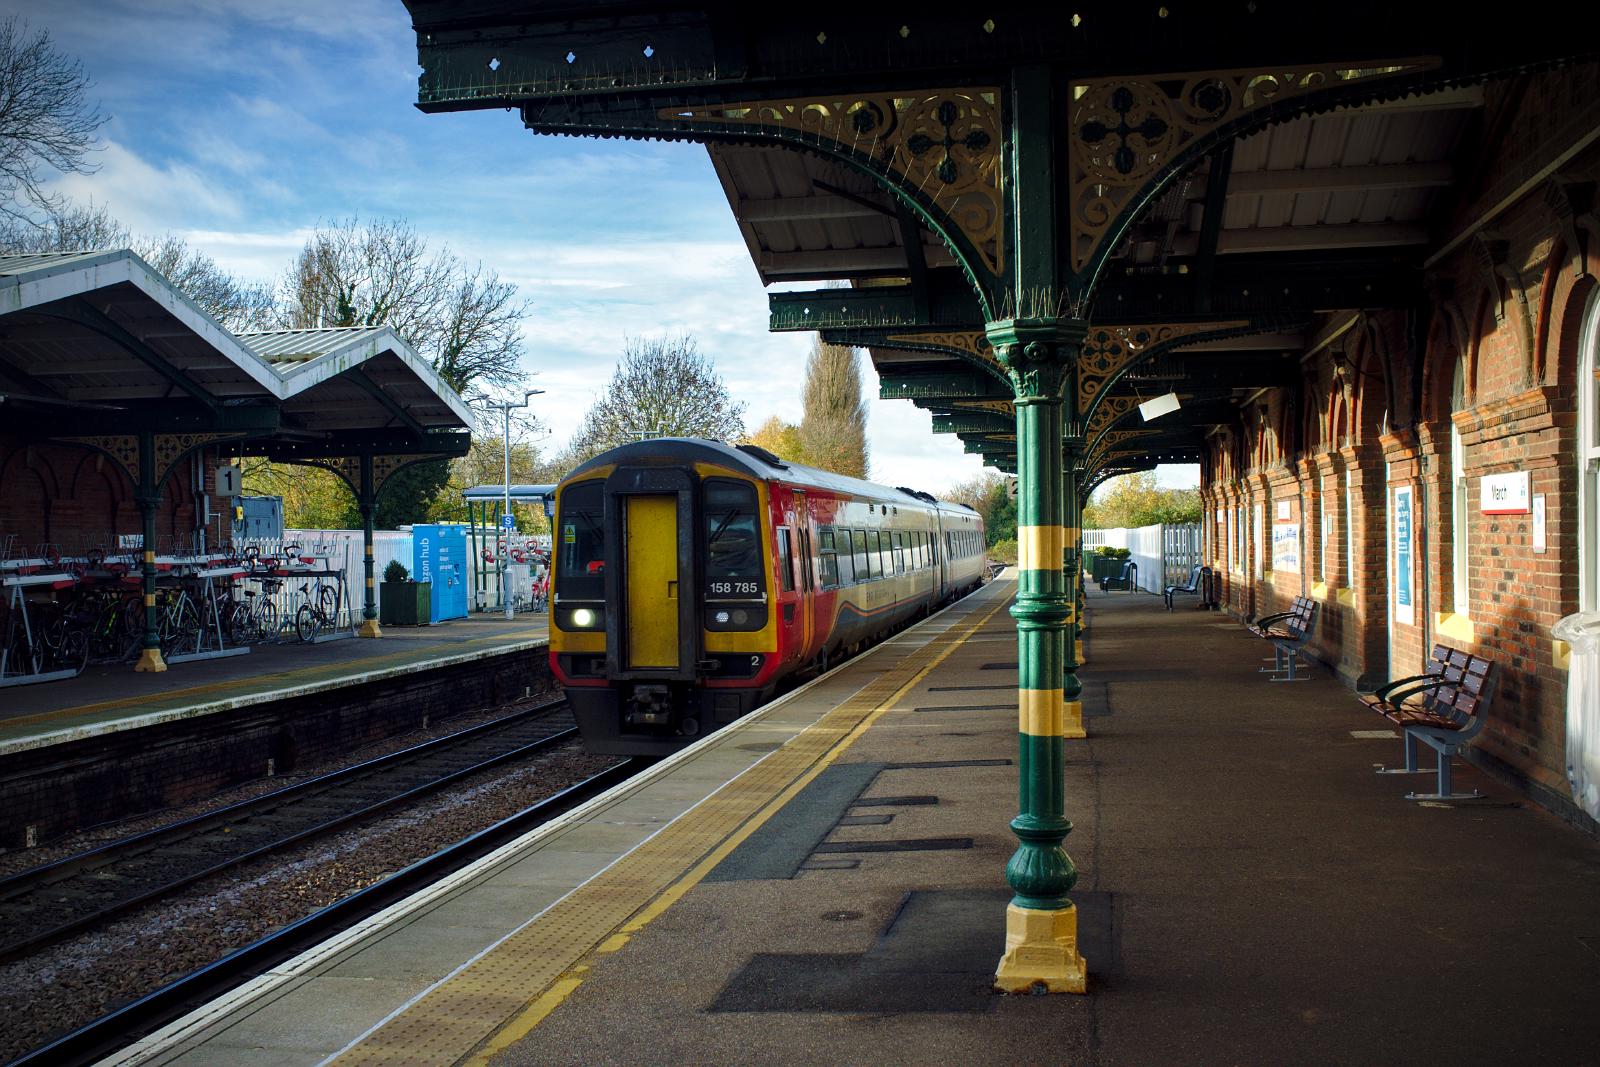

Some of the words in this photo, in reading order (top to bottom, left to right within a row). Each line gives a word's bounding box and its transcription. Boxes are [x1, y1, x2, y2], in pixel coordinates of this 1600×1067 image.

[224, 470, 232, 491] 1
[1491, 483, 1508, 501] March
[505, 517, 512, 525] S
[419, 538, 430, 558] hub
[422, 560, 430, 583] azon
[709, 582, 731, 593] 158
[734, 582, 758, 593] 785
[751, 655, 760, 666] 2
